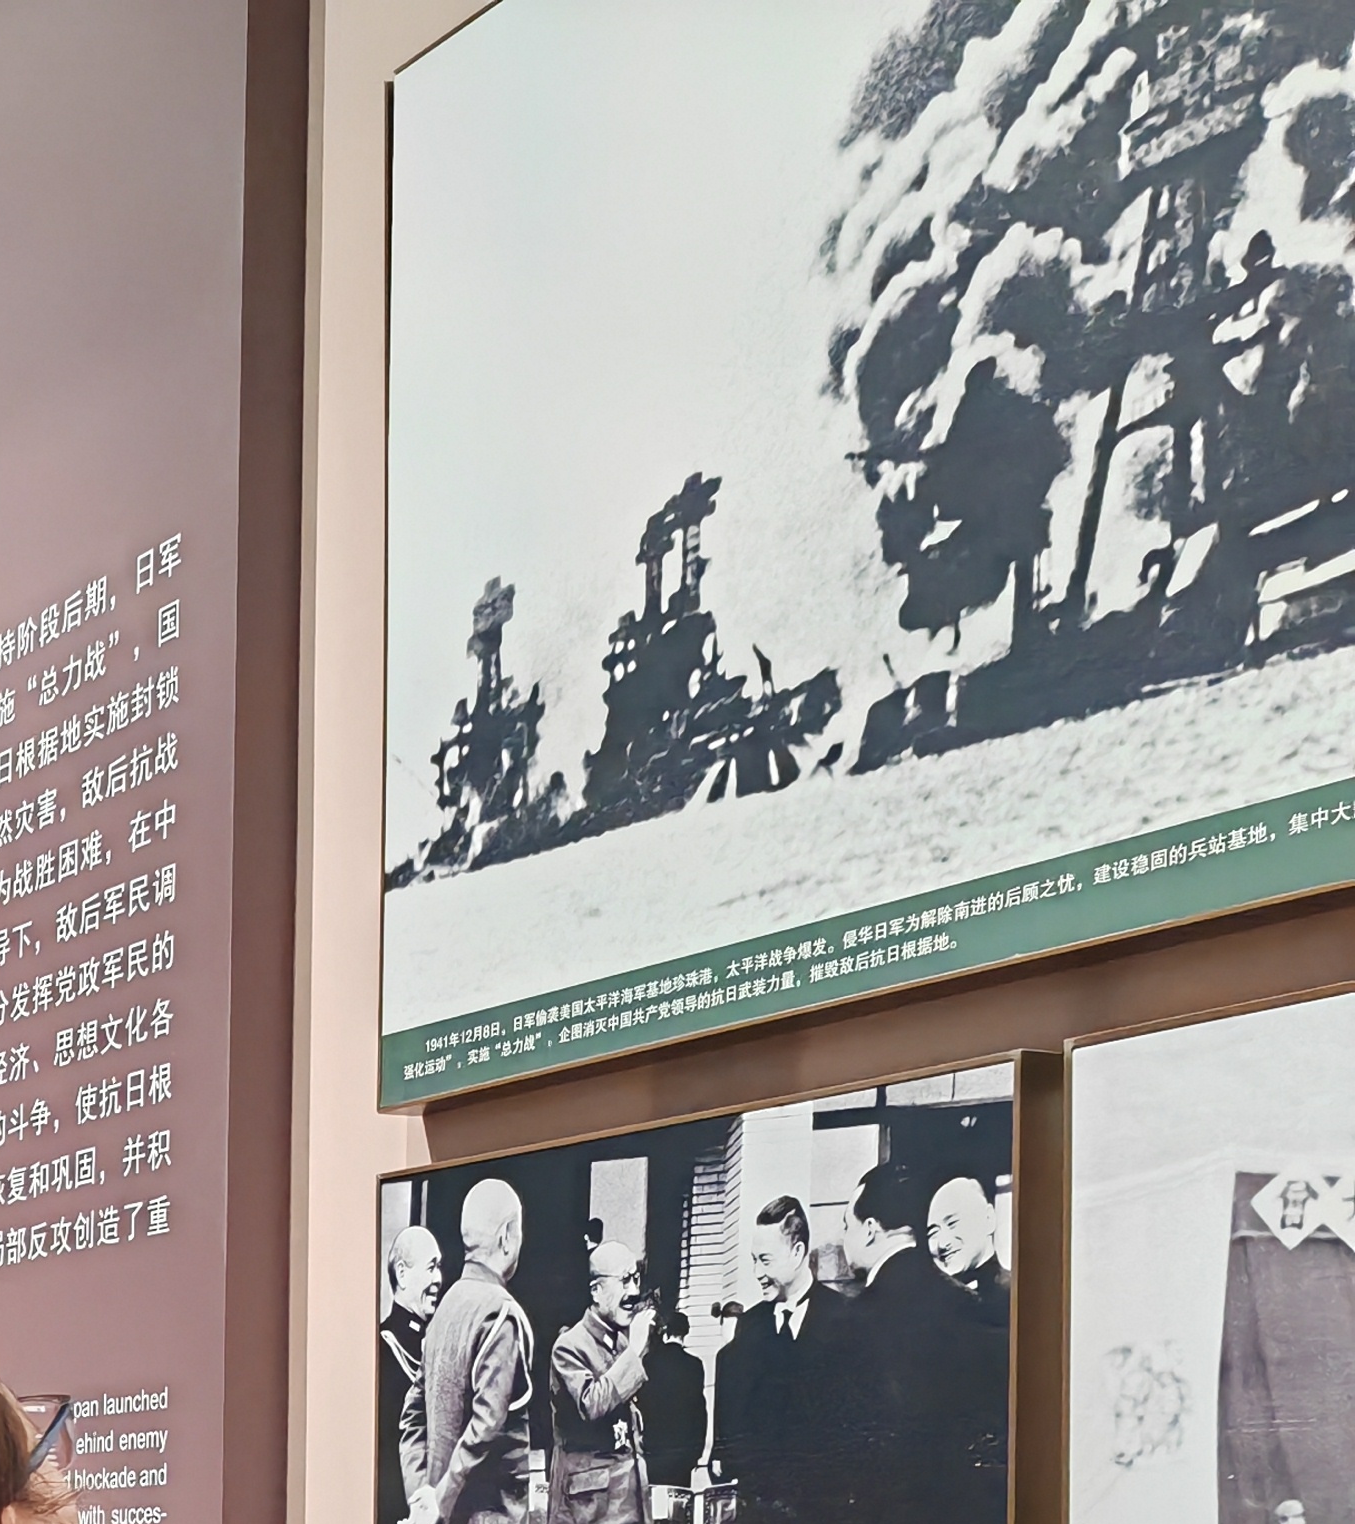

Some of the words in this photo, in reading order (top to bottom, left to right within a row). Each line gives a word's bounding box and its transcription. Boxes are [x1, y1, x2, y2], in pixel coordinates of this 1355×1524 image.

[425, 801, 1355, 1052] 1941年12月8日，日军偷袭美国太平洋海军基地珍珠港，太平洋战争爆发。侵华日军为解除南进的后顾之忧，建设稳固的兵站基地，集中大
[74, 1401, 99, 1424] pan
[104, 1386, 168, 1414] launched
[76, 1430, 114, 1455] ehind
[119, 1430, 168, 1453] enemy
[74, 1466, 136, 1490] blockade
[139, 1462, 167, 1486] and
[111, 1507, 167, 1524] succes-
